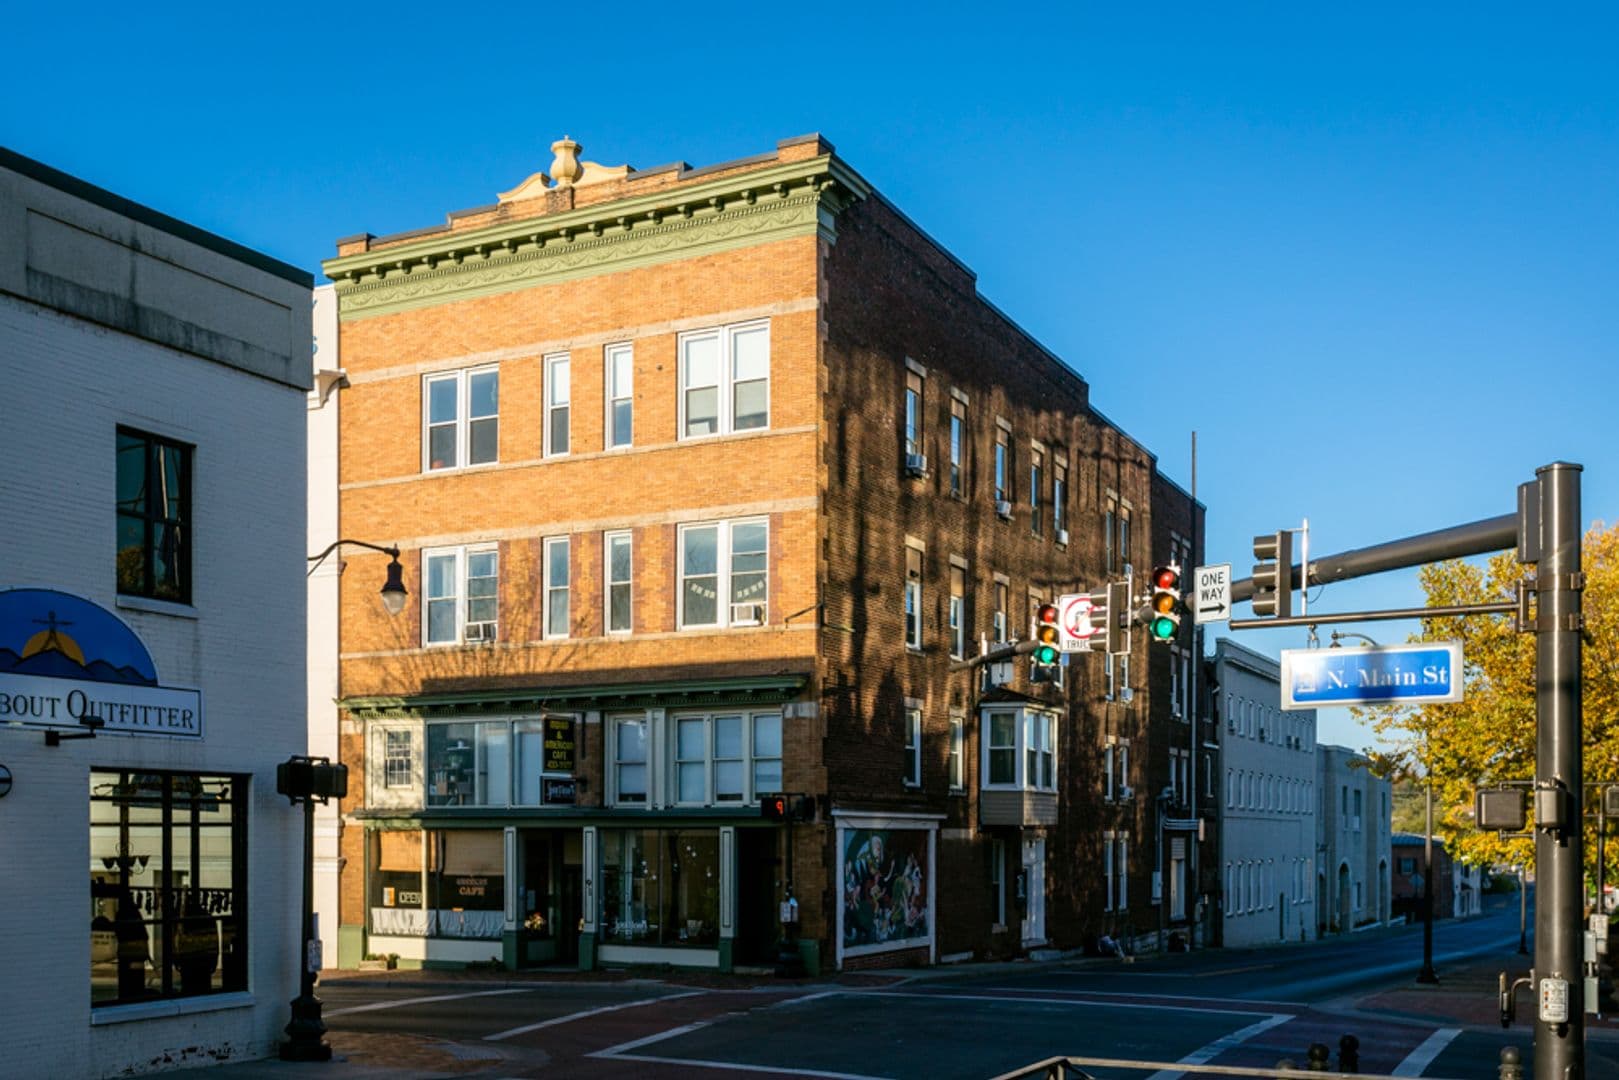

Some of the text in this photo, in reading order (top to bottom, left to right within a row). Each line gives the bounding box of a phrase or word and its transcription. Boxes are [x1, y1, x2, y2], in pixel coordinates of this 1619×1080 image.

[1201, 571, 1225, 587] ONE
[1201, 585, 1225, 601] WAY
[1066, 639, 1089, 650] TRUC
[1327, 665, 1449, 689] N. Main St
[0, 689, 195, 730] BOUT OUTFITTER
